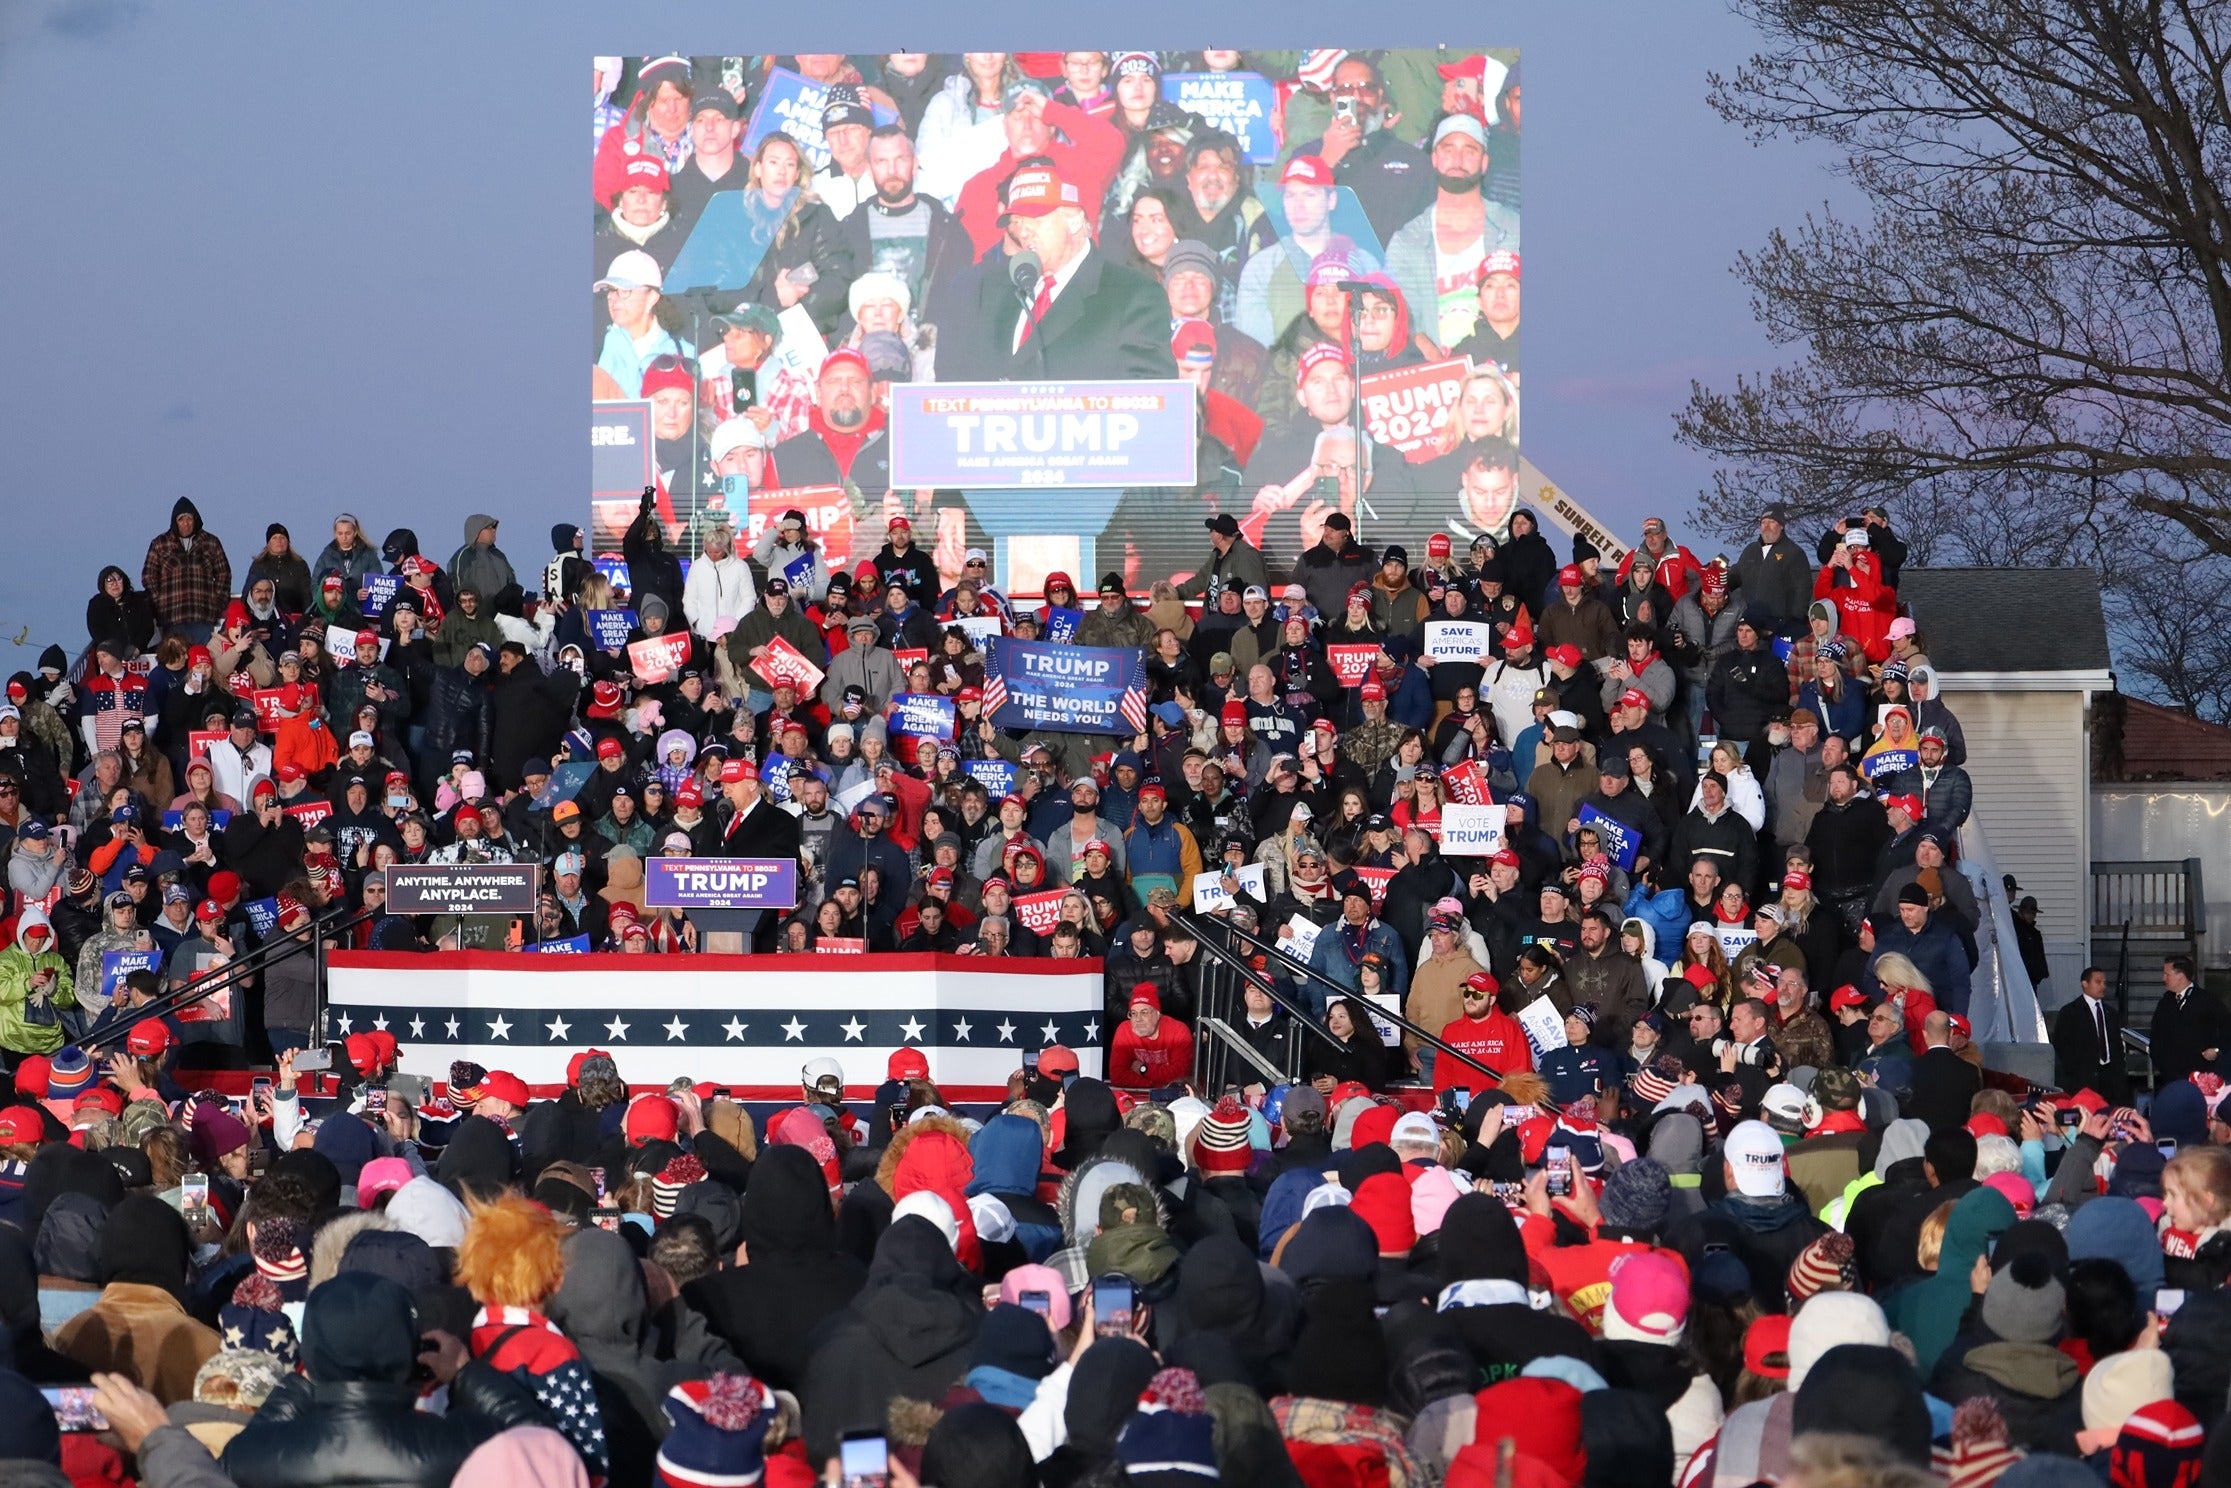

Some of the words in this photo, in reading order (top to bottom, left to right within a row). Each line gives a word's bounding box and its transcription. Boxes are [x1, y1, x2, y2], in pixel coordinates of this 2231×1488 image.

[1181, 81, 1244, 99] MAKE
[1177, 100, 1263, 118] MERICA
[927, 398, 968, 412] TEXT
[1087, 396, 1108, 410] TO
[1361, 379, 1462, 421] RUMP
[947, 413, 1139, 453] TRUMP
[957, 456, 990, 468] MAKE
[992, 456, 1045, 467] AMERICA
[1047, 455, 1085, 467] GREAT
[1020, 469, 1065, 485] 2024
[1553, 499, 1614, 552] SUNBELT
[374, 578, 396, 588] MAKE
[367, 585, 397, 596] AMERIC
[601, 613, 625, 621] MAKE
[596, 621, 633, 630] AMERICA
[1441, 627, 1473, 636] SAVE
[602, 629, 629, 638] GREAT
[1432, 637, 1483, 646] AMERICA'S
[638, 640, 687, 663] TRUMP
[1432, 646, 1481, 655] FUTURE
[647, 652, 683, 671] 2024
[771, 644, 813, 682] TRUMP
[1334, 652, 1379, 664] TRUM
[1022, 652, 1110, 677] TRUMP
[1341, 662, 1369, 674] 202
[1054, 681, 1075, 689] 2024
[907, 697, 939, 708] MAKE
[1010, 691, 1047, 708] THE
[1052, 696, 1117, 714] WORLD
[898, 704, 946, 718] AMERICA
[1024, 708, 1070, 722] NEEDS
[1074, 712, 1101, 725] YOU
[903, 714, 938, 725] GREAT
[901, 723, 940, 734] AGAIN!
[352, 733, 370, 741] TRUMP
[1876, 754, 1907, 766] MAKE
[973, 764, 1004, 773] MAKE
[970, 772, 1013, 782] MERICA
[1458, 817, 1490, 829] VOTE
[1594, 815, 1624, 837] MAKE
[1447, 830, 1498, 843] TRUMP
[664, 864, 683, 872] TEXT
[684, 864, 741, 872] PENNSYLVANIA
[742, 864, 754, 872] TO
[755, 865, 777, 873] 88022
[396, 876, 452, 887] ANYTIME.
[454, 876, 526, 886] ANYWHERE.
[674, 873, 768, 891] TRUMP
[420, 889, 502, 901] ANYPLACE.
[1015, 898, 1063, 918] TRUM
[1020, 910, 1061, 928] 2024
[121, 956, 148, 966] MAKE
[1745, 1153, 1781, 1164] TRUMP
